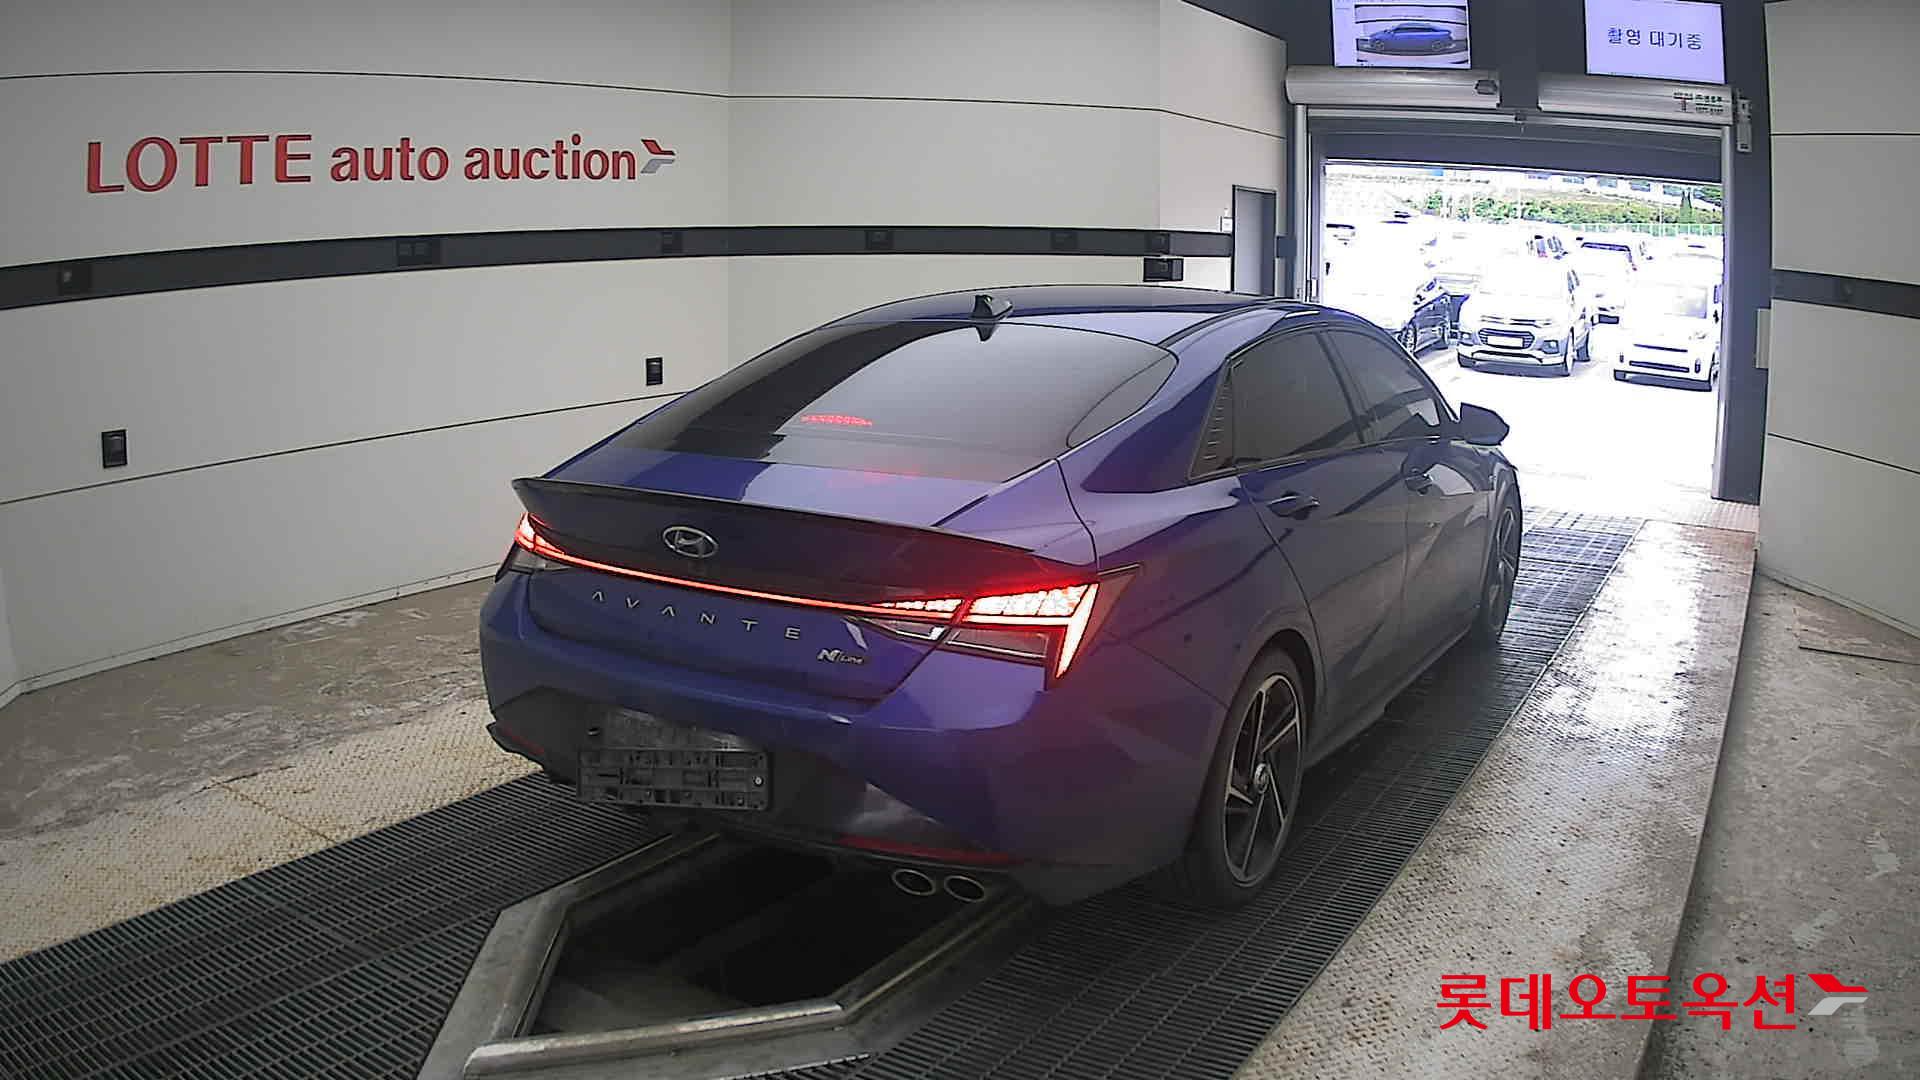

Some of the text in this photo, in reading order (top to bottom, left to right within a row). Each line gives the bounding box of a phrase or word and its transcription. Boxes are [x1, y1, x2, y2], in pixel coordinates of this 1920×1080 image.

[1608, 28, 1702, 50] 촬영 대기중
[87, 134, 637, 194] LOTTE auto auction
[592, 590, 801, 640] AVANTE
